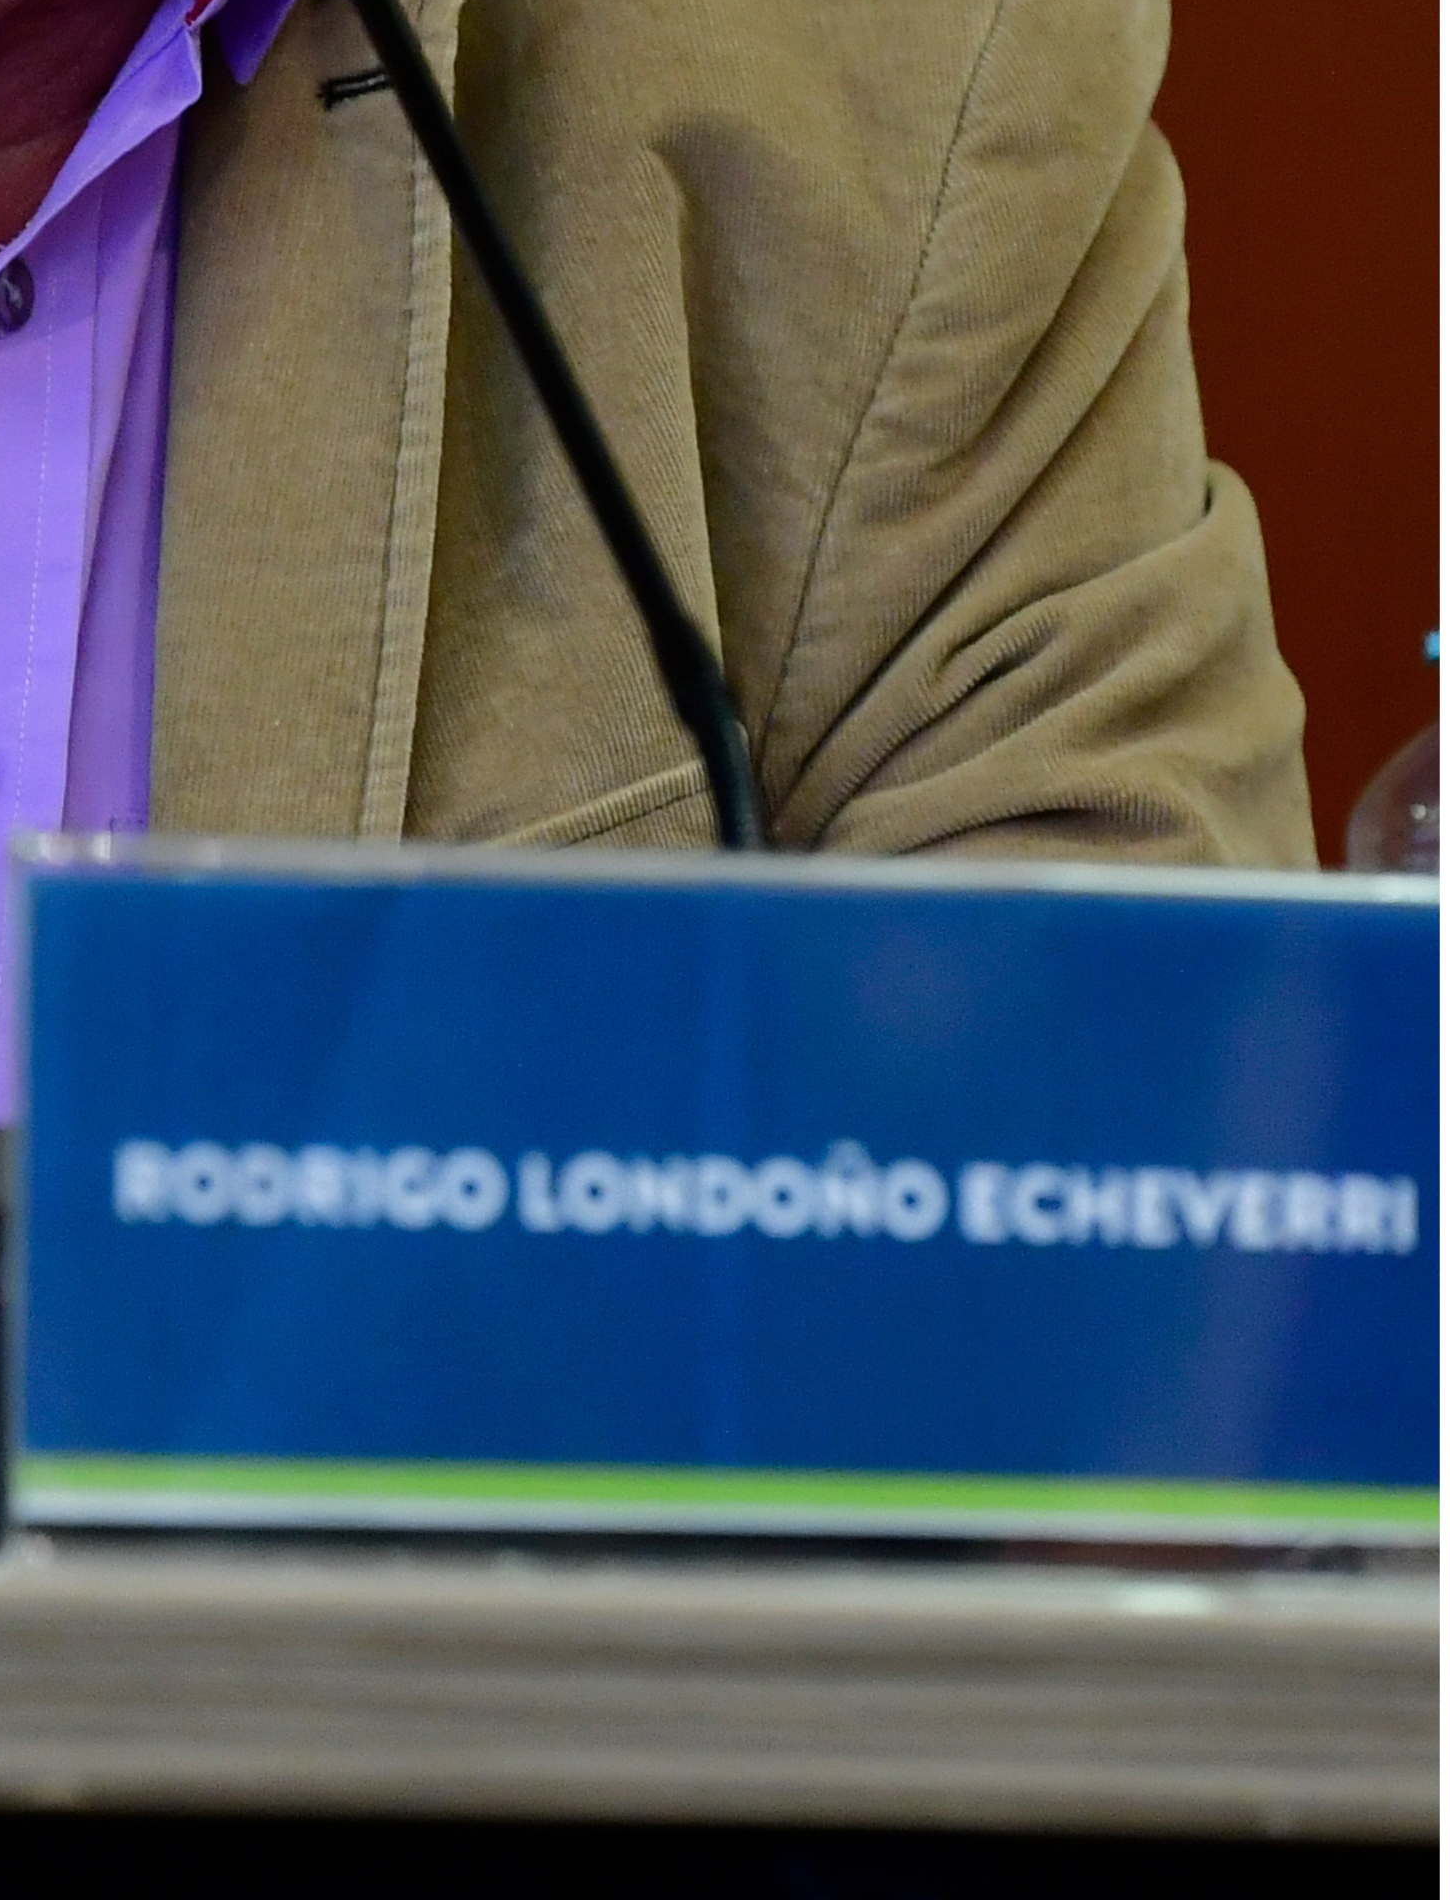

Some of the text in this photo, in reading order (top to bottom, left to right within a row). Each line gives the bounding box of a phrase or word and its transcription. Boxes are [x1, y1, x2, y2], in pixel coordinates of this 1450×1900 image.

[115, 1140, 1418, 1252] RODRIGO LONDOÑO ECHEVERRI
